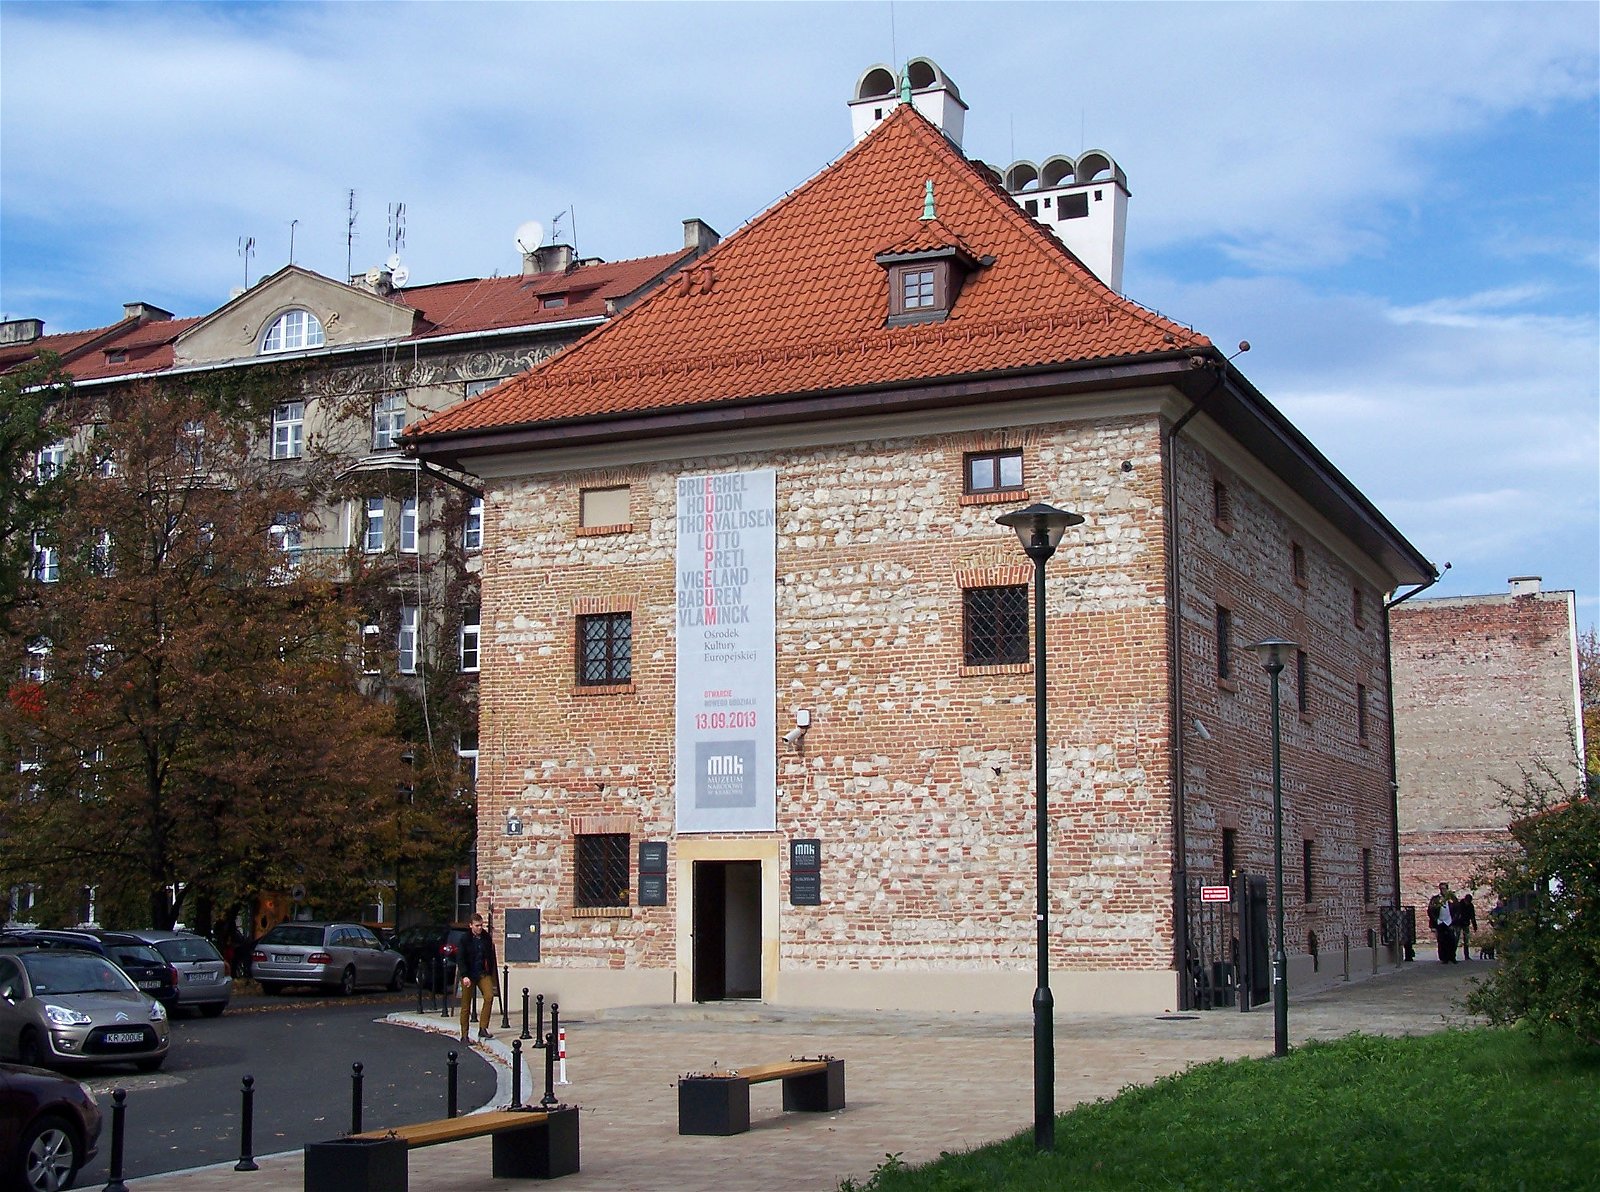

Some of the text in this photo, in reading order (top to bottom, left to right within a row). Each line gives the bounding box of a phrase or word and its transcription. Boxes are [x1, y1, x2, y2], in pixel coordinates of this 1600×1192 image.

[678, 474, 748, 497] BRUEGHEL
[687, 493, 743, 515] HOUDON
[678, 508, 774, 534] THORVALDSEN
[697, 530, 740, 551] LOTTO
[704, 549, 744, 569] PRETI
[682, 567, 749, 589] VIGELAND
[678, 587, 742, 608] BABUREN
[679, 605, 749, 627] VLAMINCK
[704, 641, 736, 651] Kultury
[704, 650, 757, 663] Europejskiej
[695, 711, 756, 729] 13.09.2013
[708, 776, 744, 784] MUZEUM
